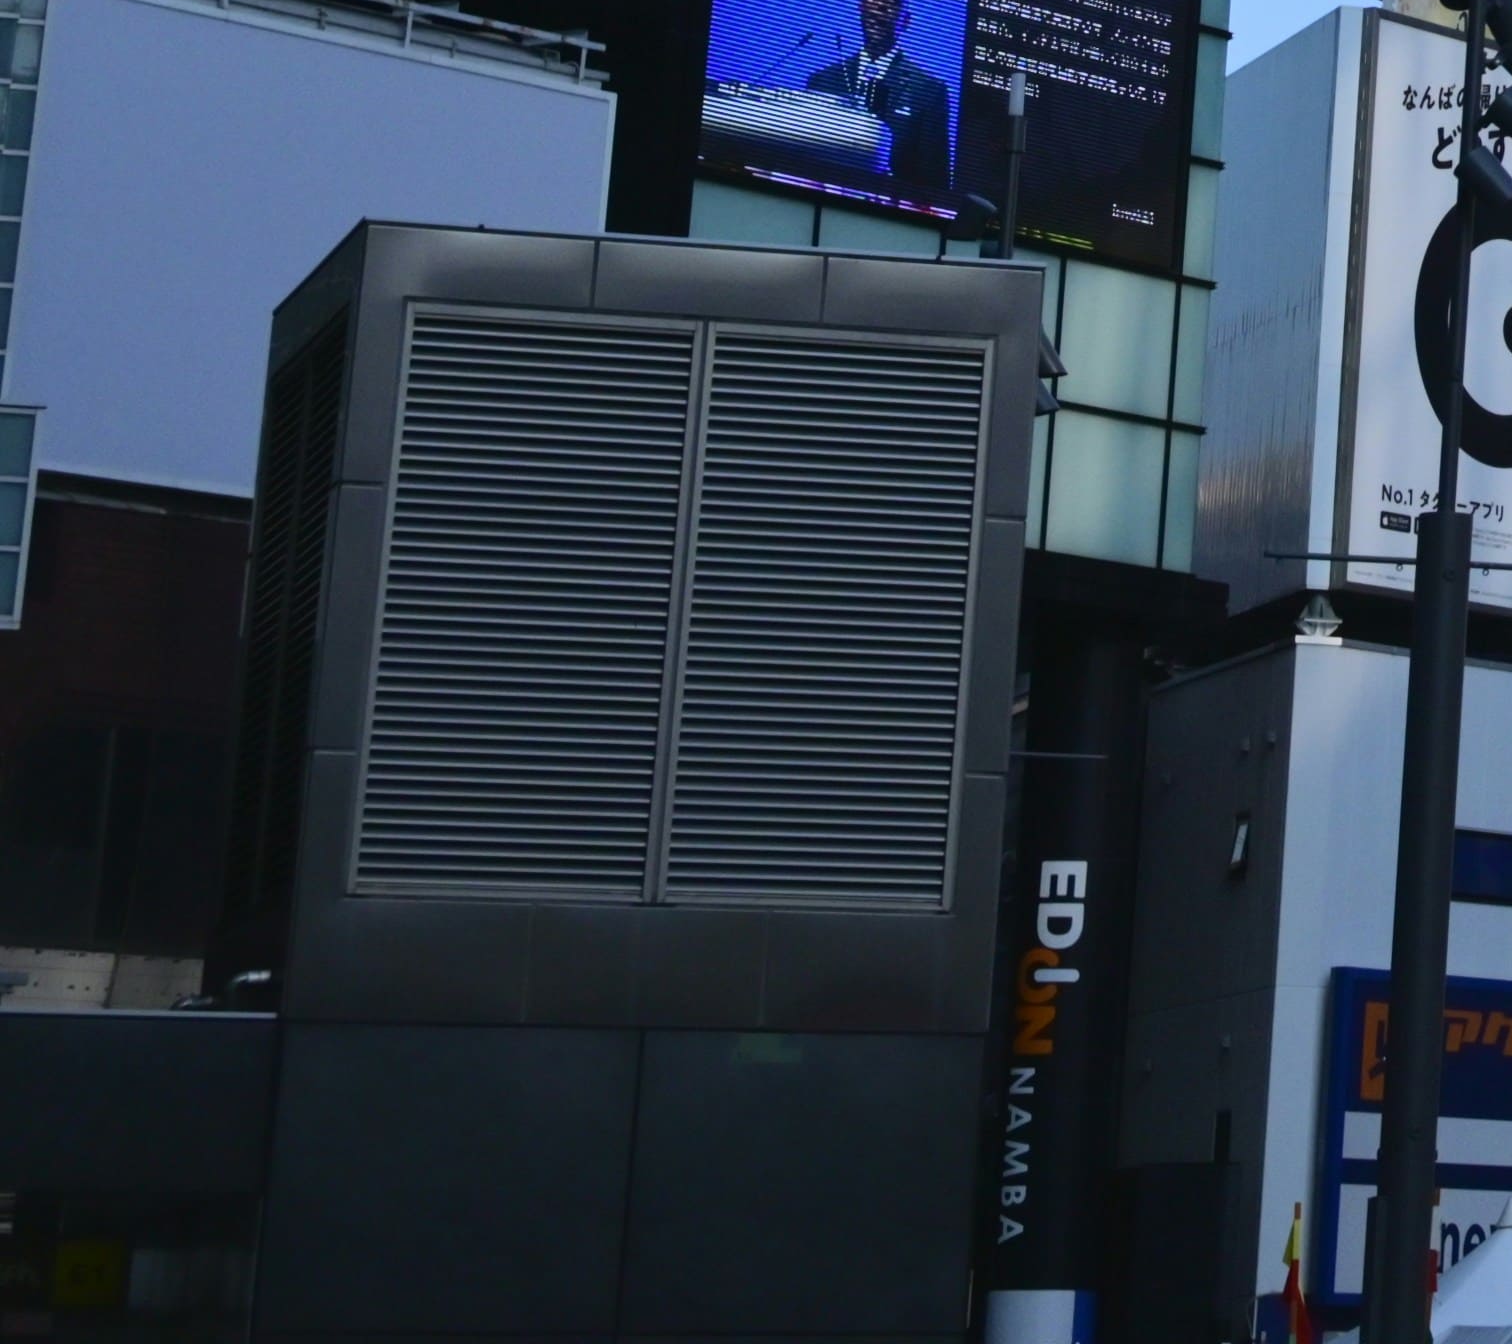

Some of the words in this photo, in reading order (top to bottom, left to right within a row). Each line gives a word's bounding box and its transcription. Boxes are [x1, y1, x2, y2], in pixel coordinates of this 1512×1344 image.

[1382, 483, 1414, 506] No.1
[1013, 859, 1088, 1056] EDION
[997, 1066, 1036, 1244] NAMBA
